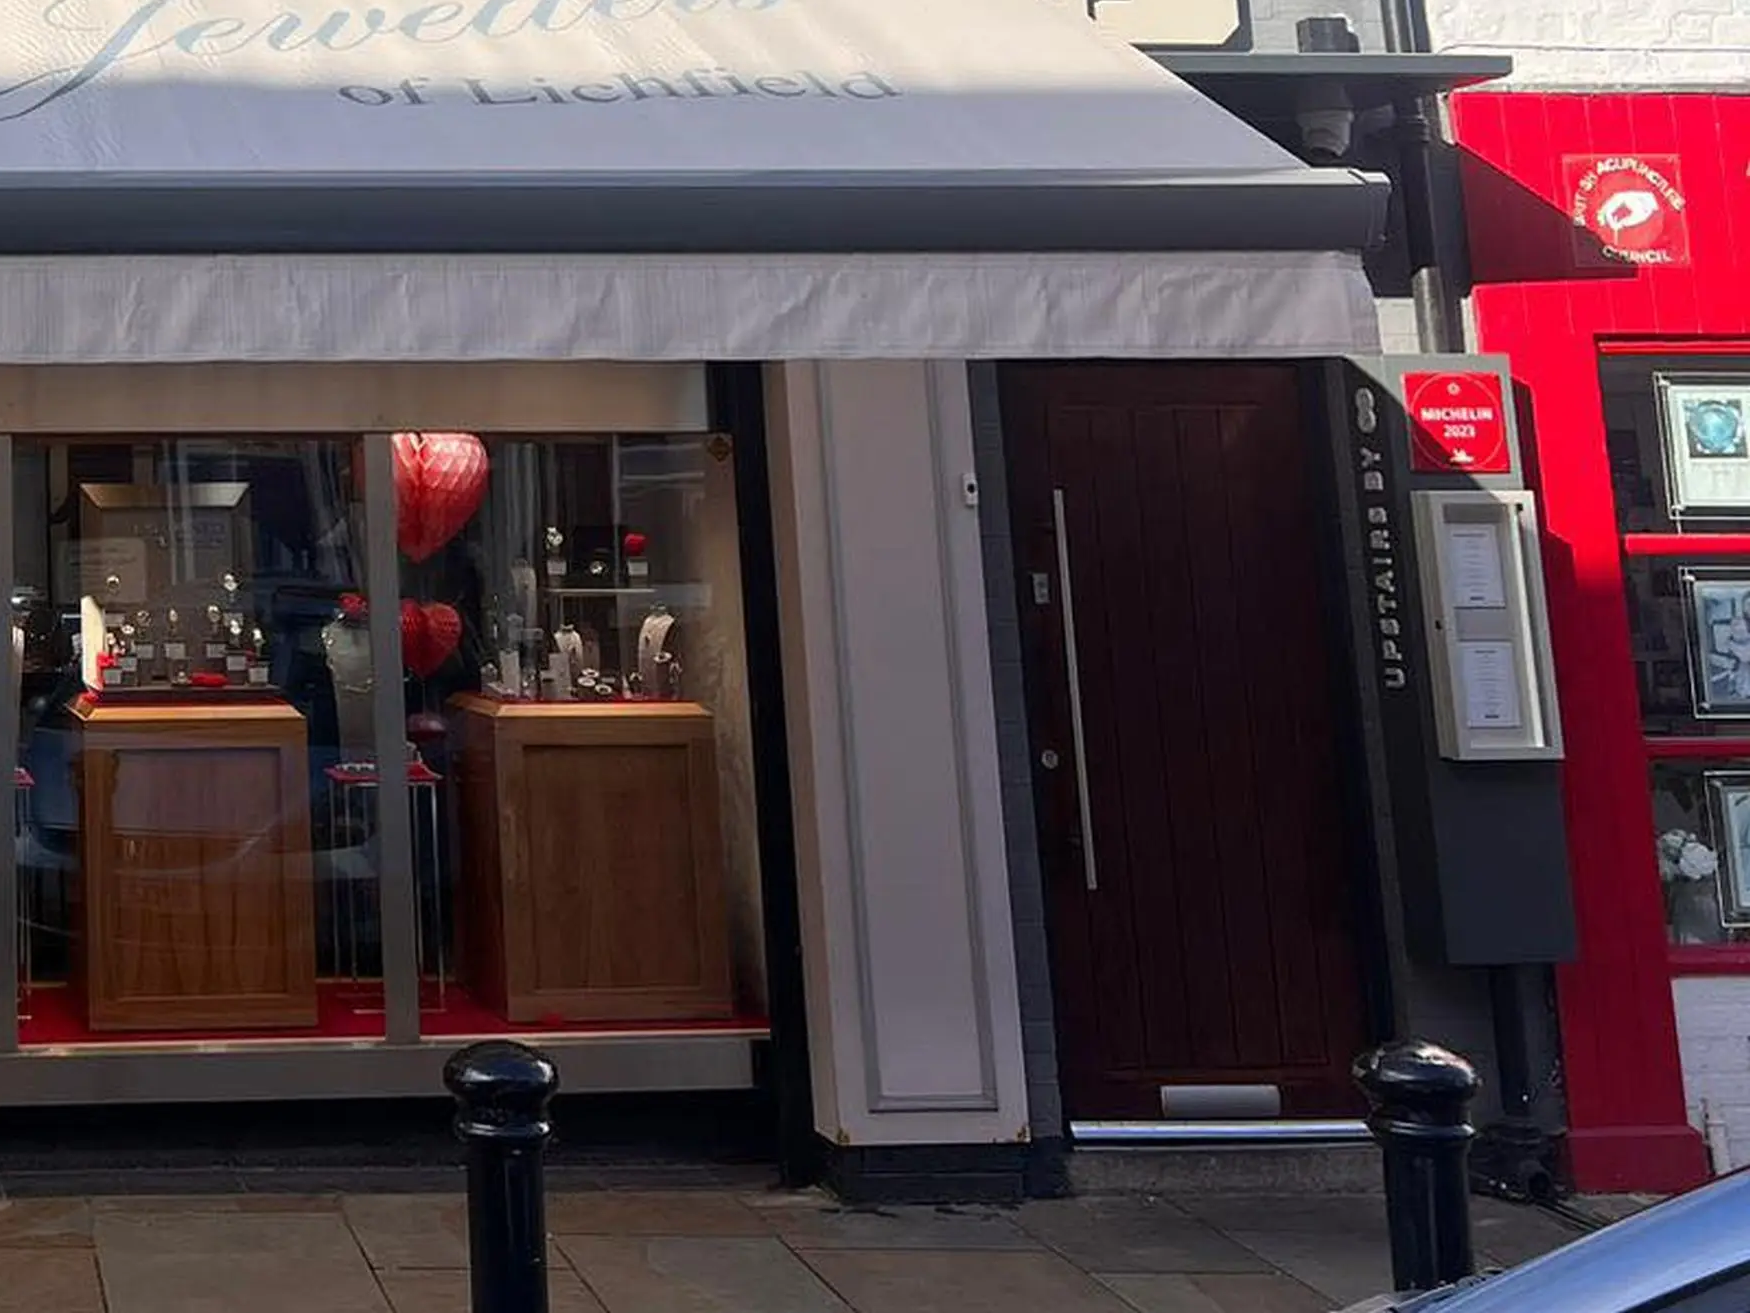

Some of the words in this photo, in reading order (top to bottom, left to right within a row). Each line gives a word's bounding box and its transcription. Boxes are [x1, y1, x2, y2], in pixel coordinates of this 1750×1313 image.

[338, 75, 432, 106] of
[471, 67, 904, 106] Lichfield
[1421, 407, 1493, 421] MICHELIN
[1359, 447, 1385, 492] BY
[1366, 506, 1406, 689] UPSTAIRS
